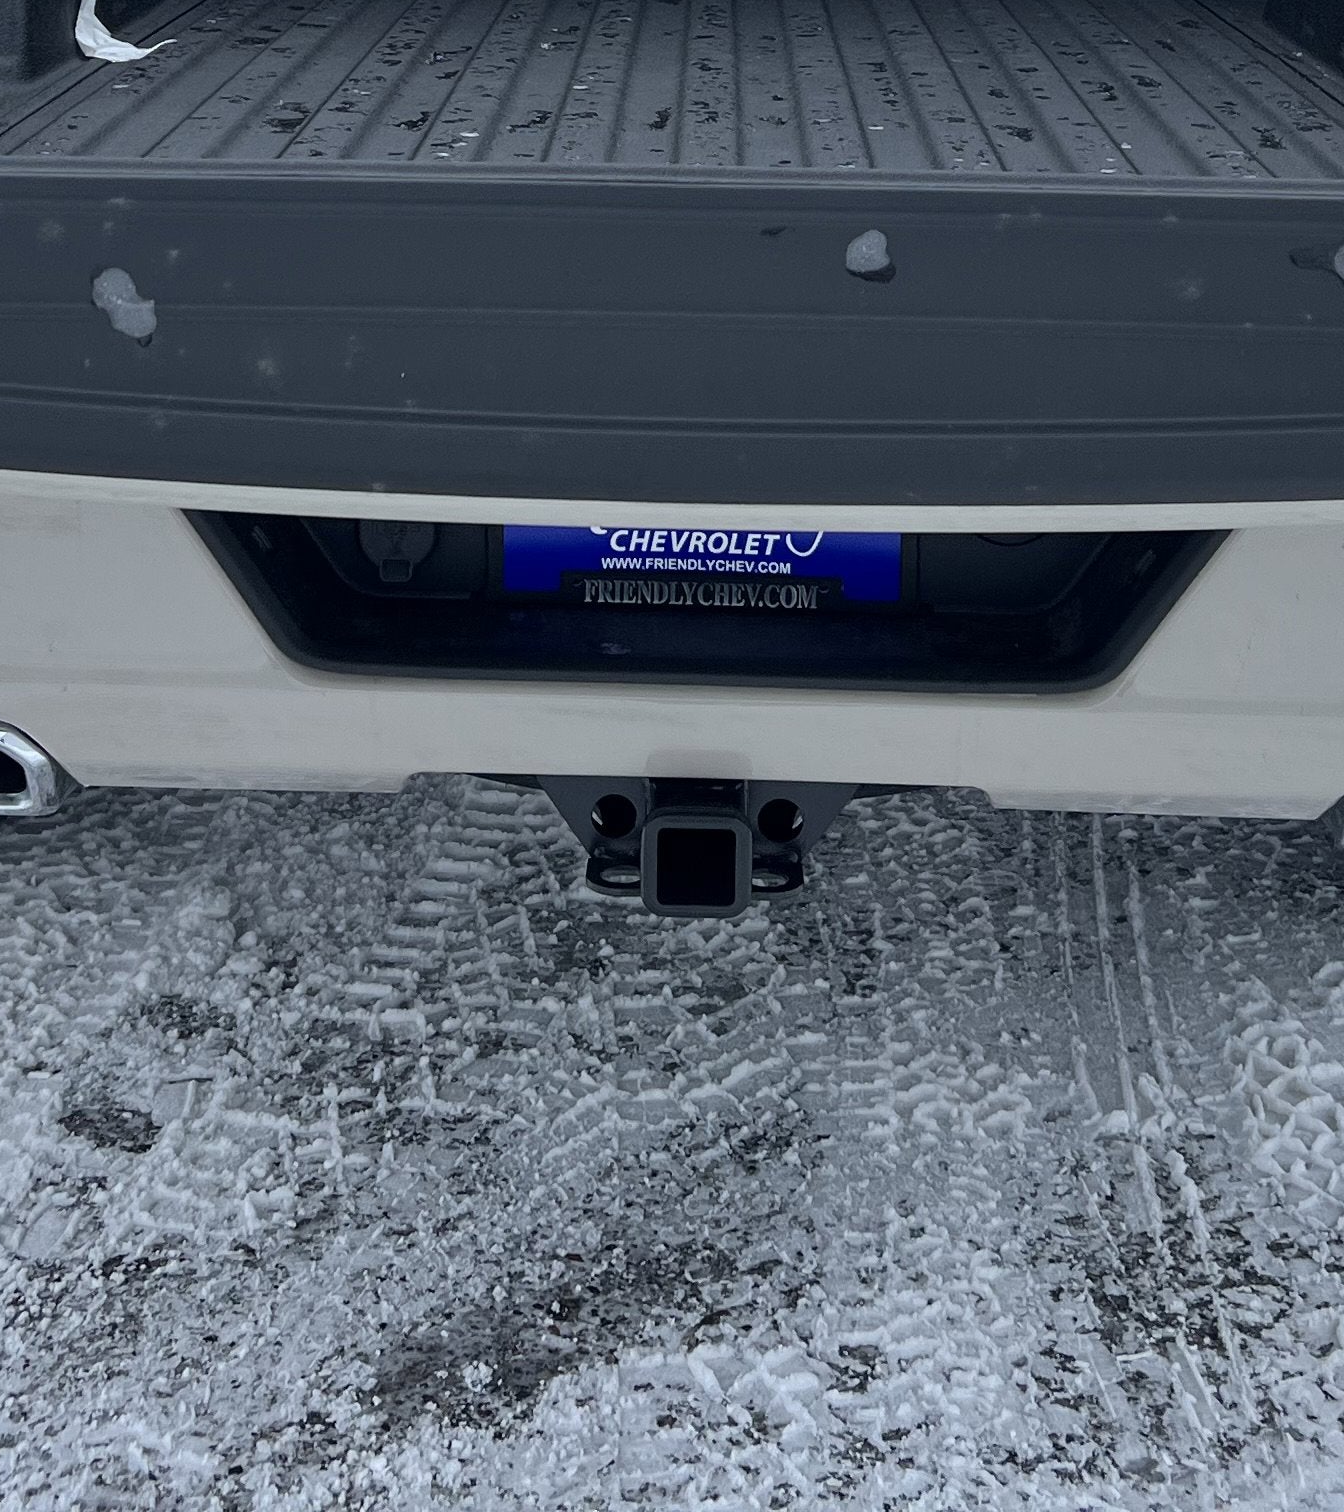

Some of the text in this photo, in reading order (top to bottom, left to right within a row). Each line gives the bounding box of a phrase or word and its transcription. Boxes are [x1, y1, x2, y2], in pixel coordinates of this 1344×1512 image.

[609, 530, 780, 555] CHEVROLET
[601, 557, 791, 575] WWW.FRIENDLYCHEV.COM
[584, 579, 818, 609] FRIENDLYCHEV.COM
